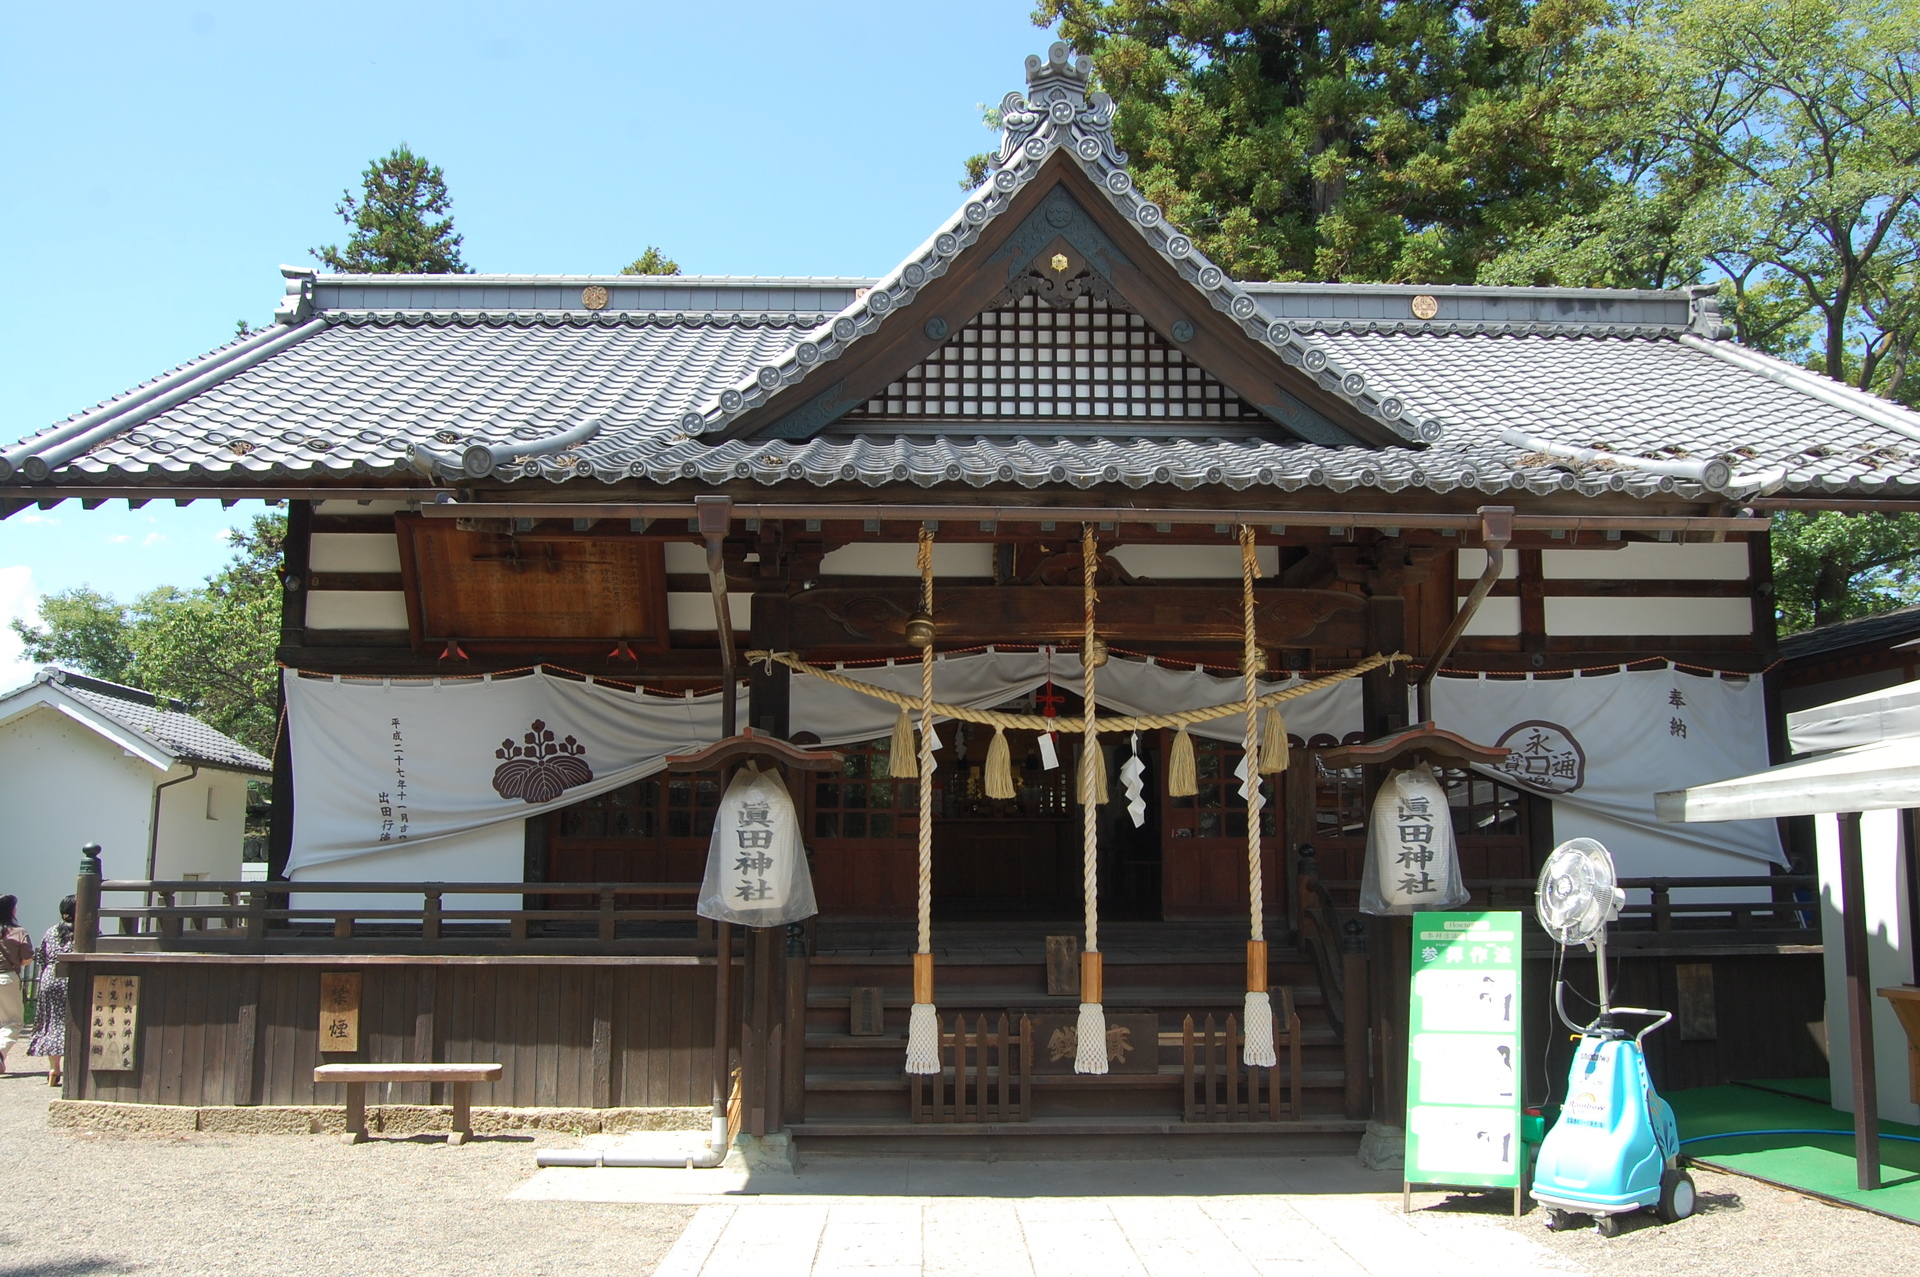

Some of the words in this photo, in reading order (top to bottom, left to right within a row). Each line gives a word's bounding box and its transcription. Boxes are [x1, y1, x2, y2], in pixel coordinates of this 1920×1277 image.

[1668, 687, 1687, 740] 奉納
[328, 985, 349, 1039] 禁煙
[1569, 1100, 1606, 1114] Rainbow
